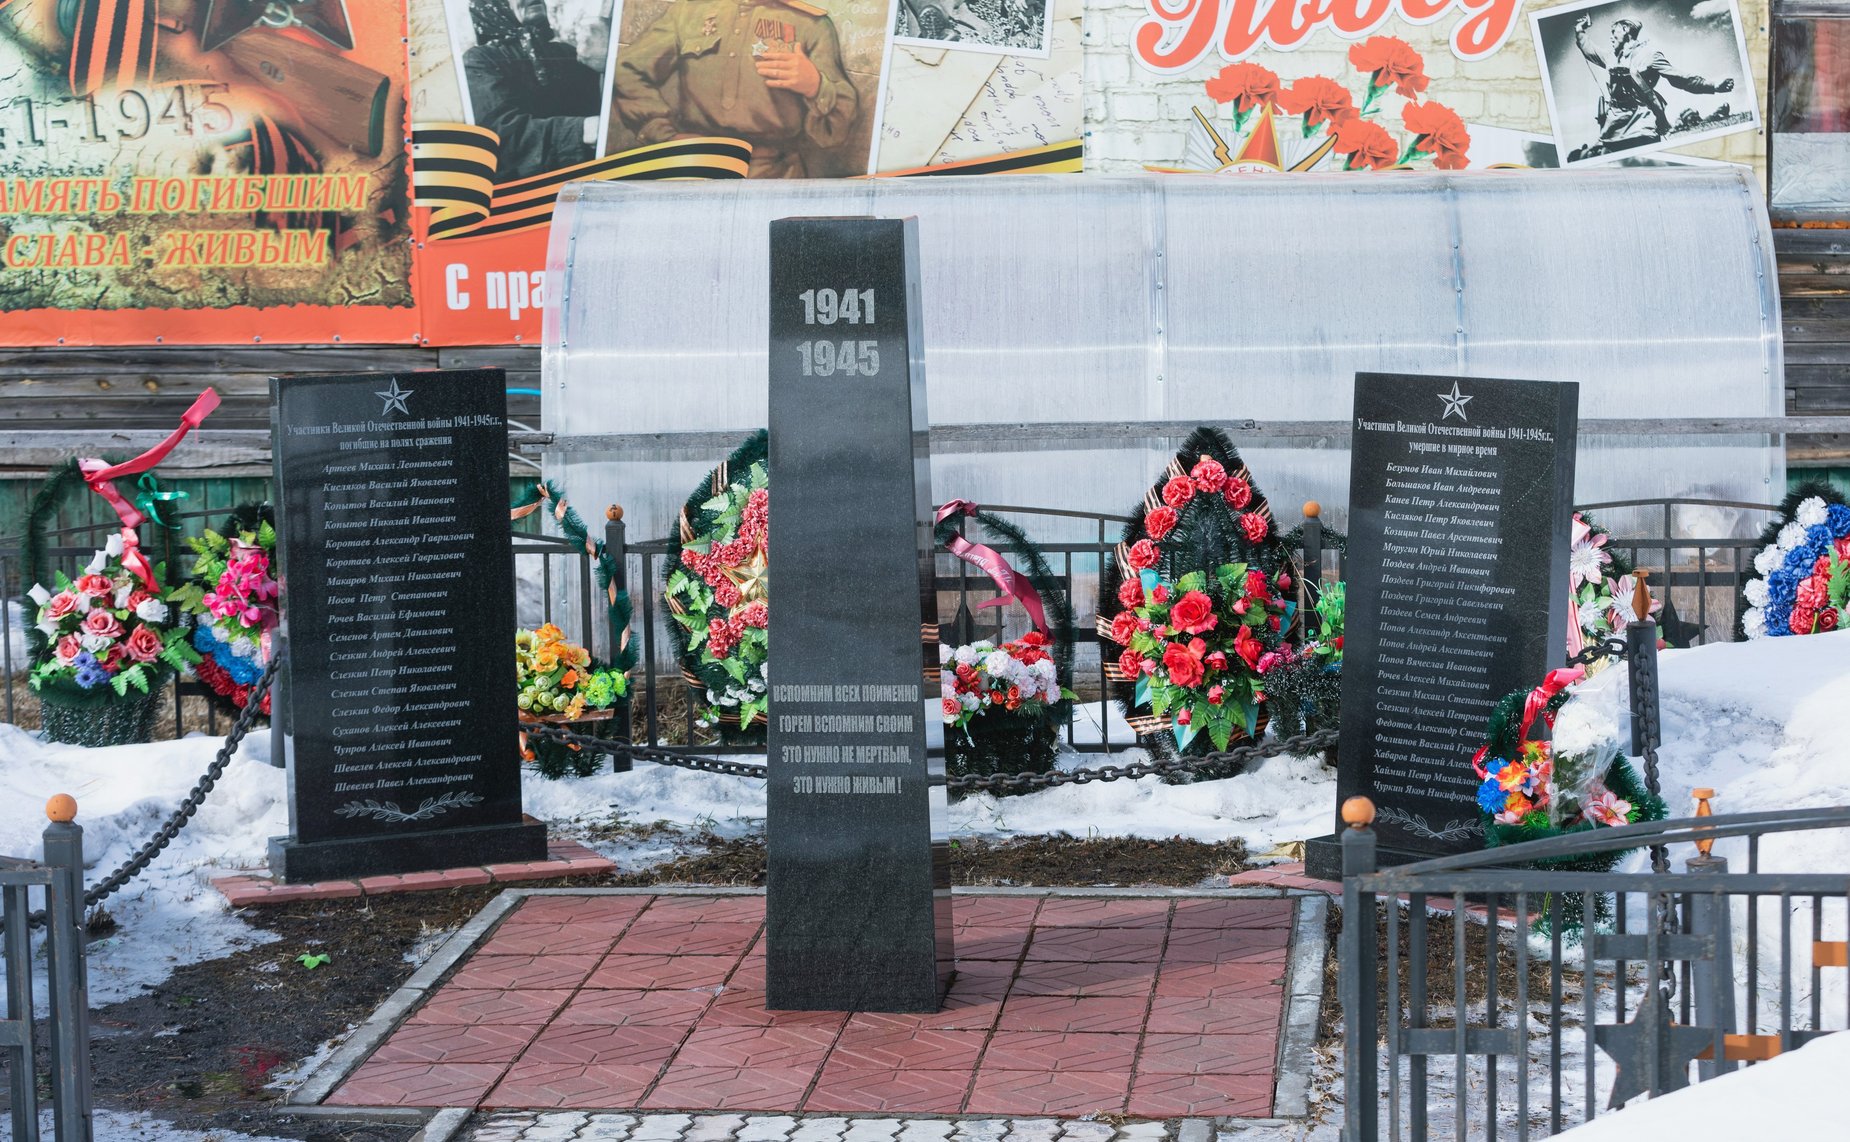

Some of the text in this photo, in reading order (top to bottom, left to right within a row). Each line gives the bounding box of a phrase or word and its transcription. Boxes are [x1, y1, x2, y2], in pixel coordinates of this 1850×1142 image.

[132, 176, 368, 211] ПОГИБШИМ
[6, 230, 329, 267] СЛАВА ЖИВЫМ
[445, 263, 470, 310] С
[799, 288, 875, 325] 1941
[796, 340, 880, 376] 1945
[286, 424, 331, 435] Участники
[332, 421, 366, 433] Великой
[367, 417, 426, 431] Отечественной
[426, 416, 453, 428] войны
[1357, 417, 1396, 431] Участники
[1396, 420, 1427, 433] Великой
[1427, 422, 1481, 437] Отечественной
[1482, 426, 1506, 438] войны
[339, 436, 453, 449] погибшие на полях сражения
[1408, 441, 1441, 454] умершие
[1447, 444, 1475, 456] мирное
[1474, 445, 1498, 458] время
[321, 459, 454, 474] Артеев Михаил Леонтьевич
[1385, 462, 1498, 478] Безумов Иван Михайлович
[322, 477, 458, 491] Кисляков Василий Яковлевич
[1385, 478, 1501, 495] Большаков Иван Андреевич
[323, 496, 455, 510] Копытов Василий Иванович
[1384, 494, 1500, 512] Канев Петр Александрович
[324, 515, 457, 529] Копытов Николай Иванович
[1384, 510, 1495, 527] Кисляков Петр Яковлевич
[325, 533, 475, 550] Коротаев Александр Гаврилович
[1383, 525, 1503, 544] Козицин Павел Арсентьевич
[325, 552, 465, 568] Коротаев Алексей Гаврилович
[1382, 542, 1498, 560] Моругин Юрий Николаевич
[1381, 558, 1491, 576] Поздеев Андрей Иванович
[326, 571, 462, 586] Макаров Михаил Николаевич
[1381, 573, 1516, 595] Поздеев Григорий Никифорович
[327, 590, 448, 604] Носов Петр Степанович
[1380, 589, 1504, 610] Поздеев Григорий Савельевич
[327, 609, 447, 623] Рочев Василий Ефимович
[1379, 605, 1487, 624] Поздеев Семен Андреевич
[328, 627, 454, 642] Семенов Артем Данилович
[1379, 621, 1508, 643] Попов Александр Аксентьевич
[329, 645, 456, 660] Слезкин Андрей Алексеевич
[1378, 637, 1494, 657] Попов Андрей Аксентьевич
[330, 664, 453, 679] Слезкин Петр Николаевич
[1378, 653, 1488, 673] Попов Вячеслав Иванович
[1377, 669, 1490, 690] Рочев Алексей Михайлович
[330, 682, 457, 698] Слезкин Степан Яковлевич
[773, 685, 918, 702] ВСПОМНИМ ВСЕХ ПОИМЕННО
[1376, 685, 1411, 697] Слезкин
[1412, 689, 1446, 701] Михаил
[331, 700, 471, 717] Слезкин Федор Александрович
[1376, 701, 1410, 713] Слезкин
[1410, 706, 1445, 717] Алексей
[332, 719, 462, 737] Суханов Алексей Алексеевич
[779, 715, 913, 733] ГОРЕМ ВСПОМНИМ СВОИМ
[1375, 717, 1458, 737] Федотов Александр
[333, 738, 452, 756] Чупров Алексей Иванович
[1418, 738, 1455, 751] Василий
[333, 754, 482, 773] Шевелев Алексей Александрович
[782, 746, 801, 763] ЭТО
[804, 746, 840, 763] НУЖНО
[842, 746, 854, 763] НЕ
[1373, 748, 1446, 766] Хабаров Василий
[1372, 764, 1432, 782] Хаймин Петр
[334, 773, 474, 792] Шевелев Павел Александрович
[793, 776, 896, 794] ЭТО НУЖНО ЖИВЫМ
[1373, 780, 1426, 795] Чуркин Яков
